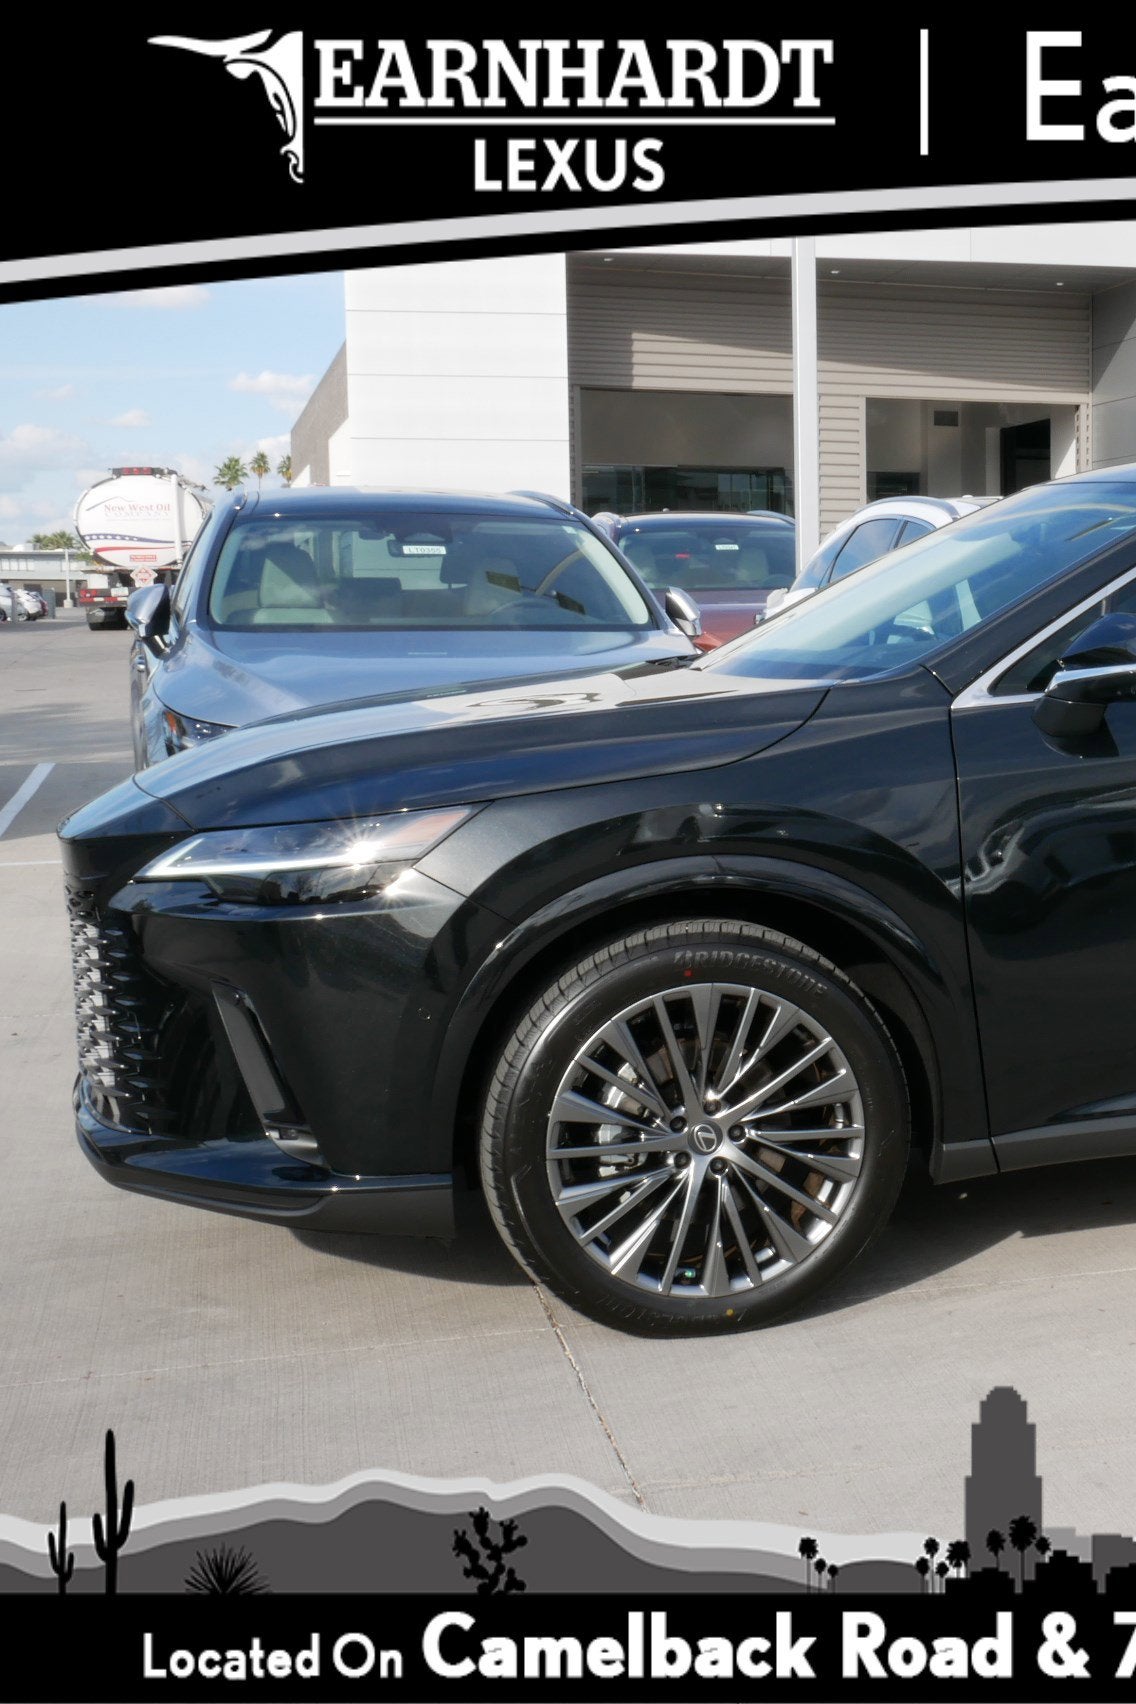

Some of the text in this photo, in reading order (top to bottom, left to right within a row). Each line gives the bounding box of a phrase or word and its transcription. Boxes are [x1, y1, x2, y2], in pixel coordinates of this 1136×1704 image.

[104, 503, 170, 512] New West Oil
